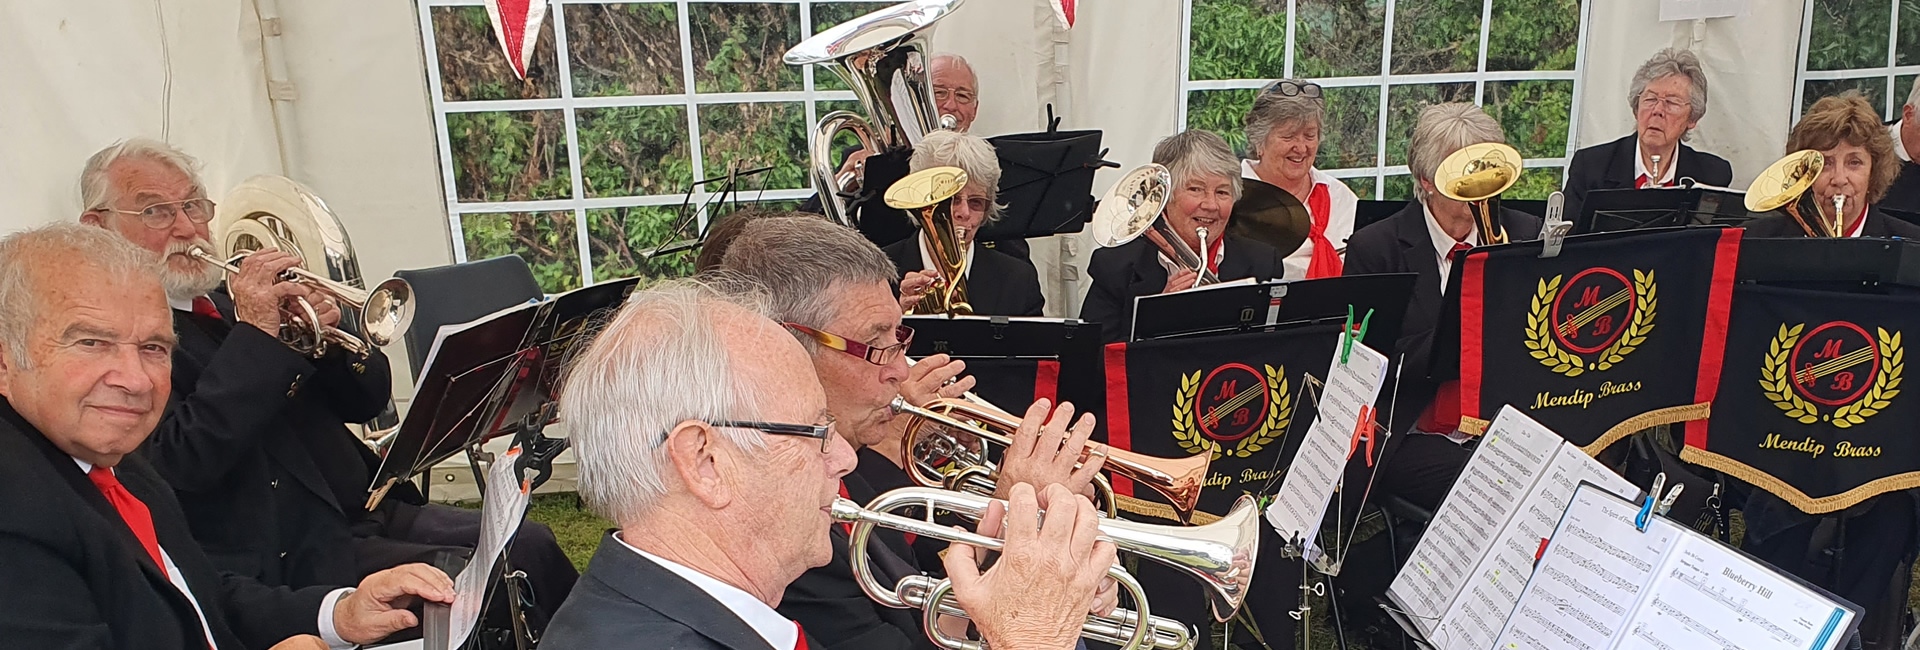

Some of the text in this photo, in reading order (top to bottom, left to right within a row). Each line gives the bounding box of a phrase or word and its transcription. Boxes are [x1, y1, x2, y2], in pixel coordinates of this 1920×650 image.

[1573, 285, 1601, 309] M
[1592, 314, 1613, 336] B
[1813, 338, 1843, 359] M
[1830, 371, 1855, 391] B
[1530, 380, 1642, 410] Mendip Brass
[1758, 432, 1882, 459] Mendip Brass
[1722, 566, 1757, 593] Blueberry
[1757, 585, 1774, 600] Hill
